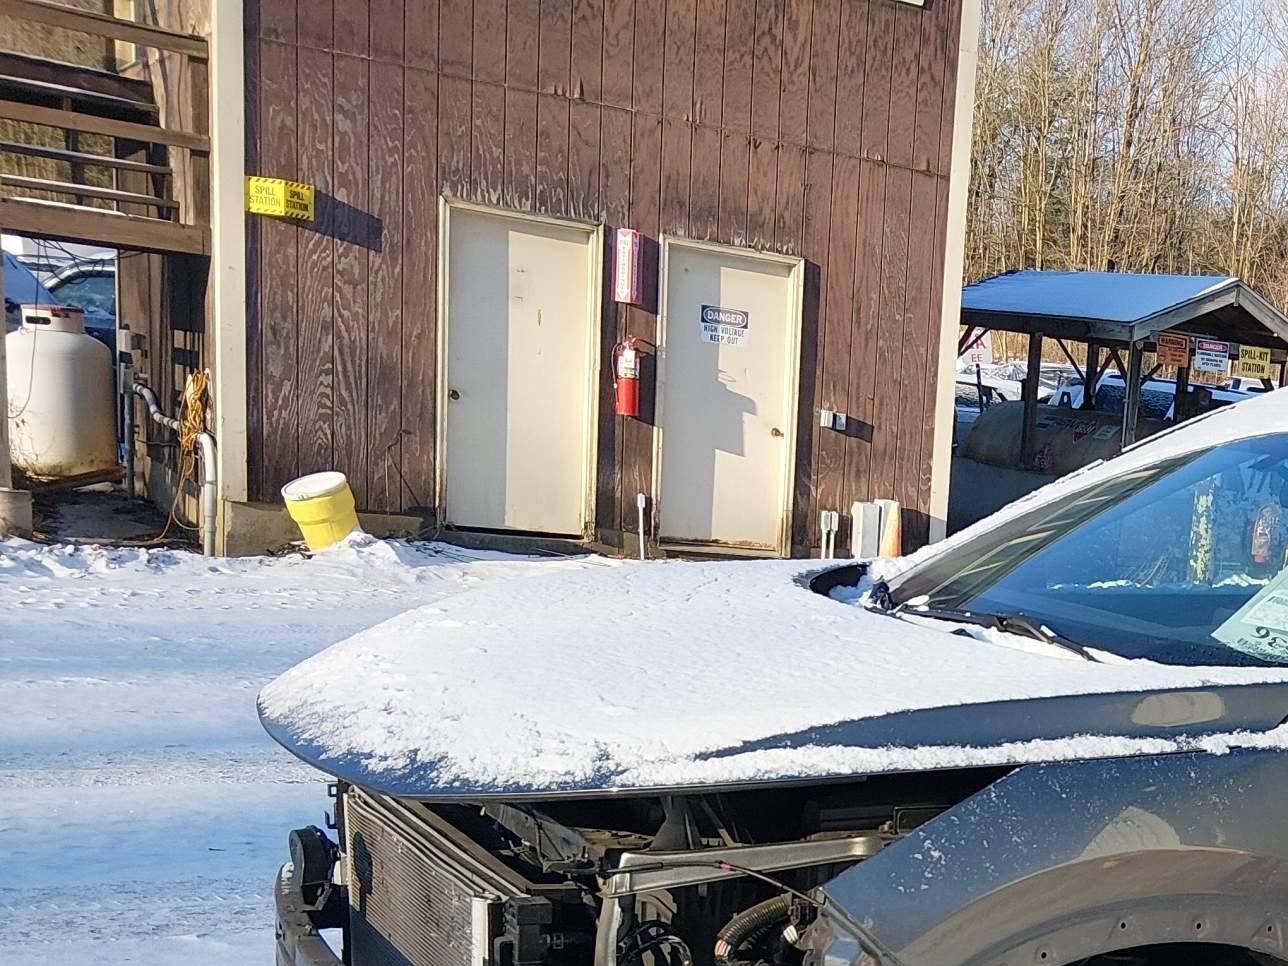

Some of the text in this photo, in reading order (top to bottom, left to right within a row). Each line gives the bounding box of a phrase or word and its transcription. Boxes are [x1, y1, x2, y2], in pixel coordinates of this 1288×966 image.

[254, 184, 276, 196] SPILL
[289, 189, 304, 201] SPILL
[249, 195, 281, 208] STATION
[286, 199, 309, 212] STATION
[707, 310, 743, 324] DANGER
[703, 324, 745, 338] HIGH VOLTAGE
[709, 333, 739, 345] KEEP OUT
[1241, 362, 1266, 374] STATION
